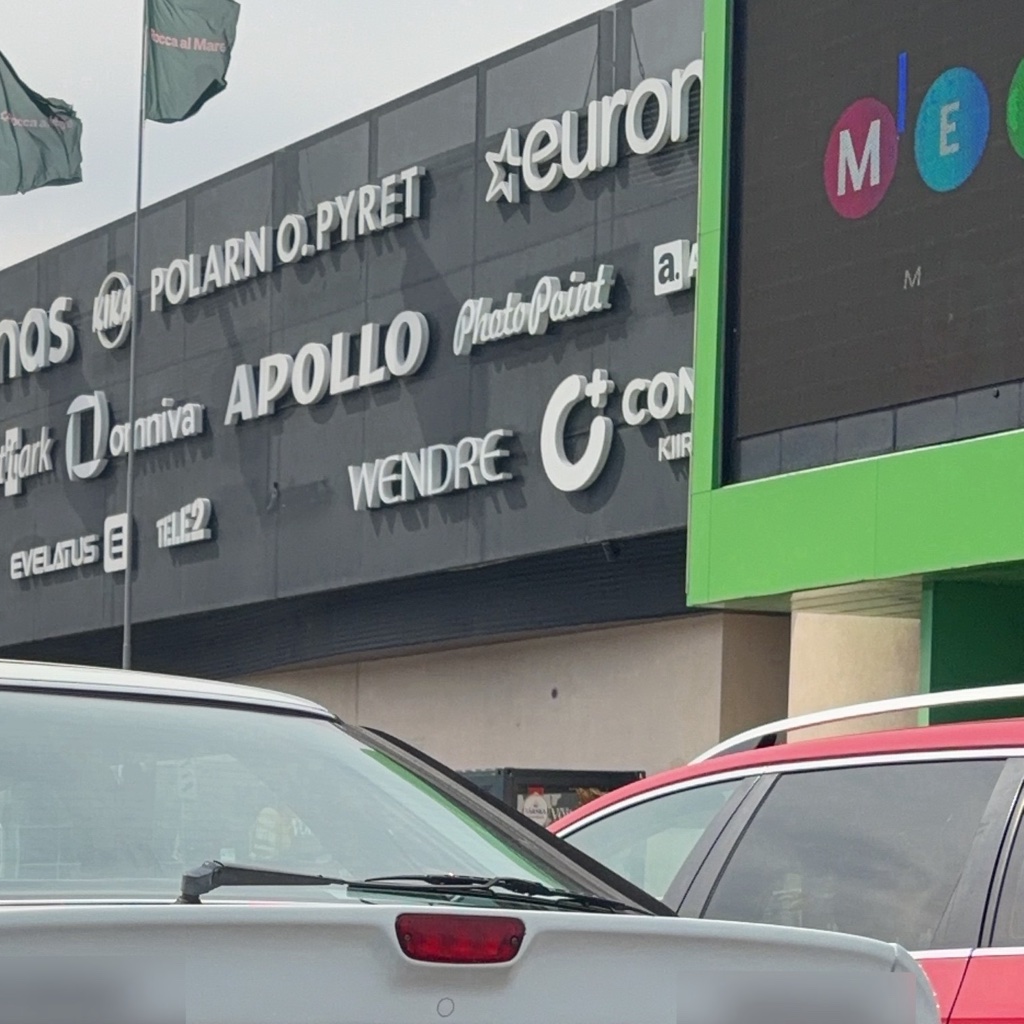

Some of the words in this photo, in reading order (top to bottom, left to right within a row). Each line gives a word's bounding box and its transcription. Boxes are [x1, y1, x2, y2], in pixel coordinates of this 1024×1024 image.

[150, 226, 272, 311] POLARN
[316, 166, 426, 251] PYRET
[453, 264, 614, 356] PhotoPoint
[224, 311, 430, 425] APOLLO
[348, 429, 514, 510] WENDRE
[11, 534, 100, 580] EVELATUS
[156, 498, 211, 549] TELE2
